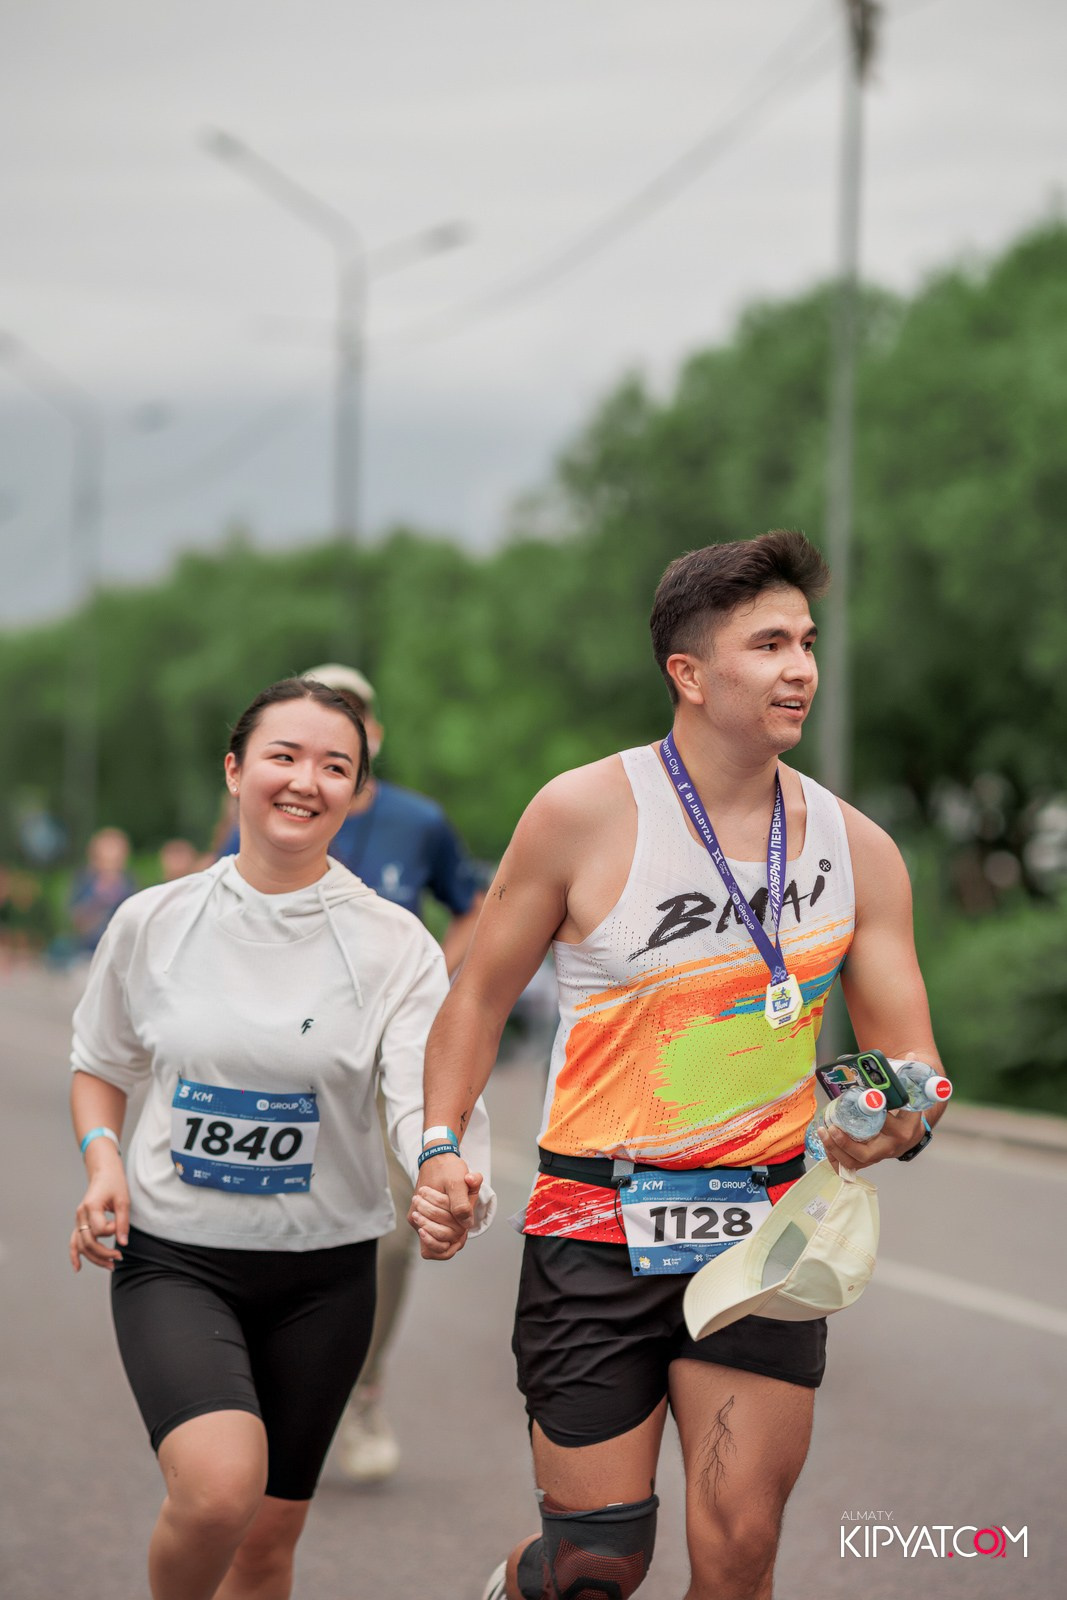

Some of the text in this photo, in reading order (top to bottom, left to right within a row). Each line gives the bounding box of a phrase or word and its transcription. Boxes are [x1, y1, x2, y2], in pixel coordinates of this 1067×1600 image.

[669, 758, 680, 776] City
[685, 792, 714, 844] BI JULDYZAI
[770, 783, 781, 849] ПЕРЕМЕНА
[770, 850, 781, 903] ДОБРЫМ
[738, 904, 755, 930] GROUP
[179, 1085, 214, 1103] 5 KM
[270, 1102, 299, 1110] GROUP
[183, 1117, 303, 1162] 1840
[627, 1180, 664, 1193] 5 KM
[710, 1180, 720, 1190] BI
[722, 1181, 747, 1189] GROUP
[650, 1206, 753, 1242] 1128
